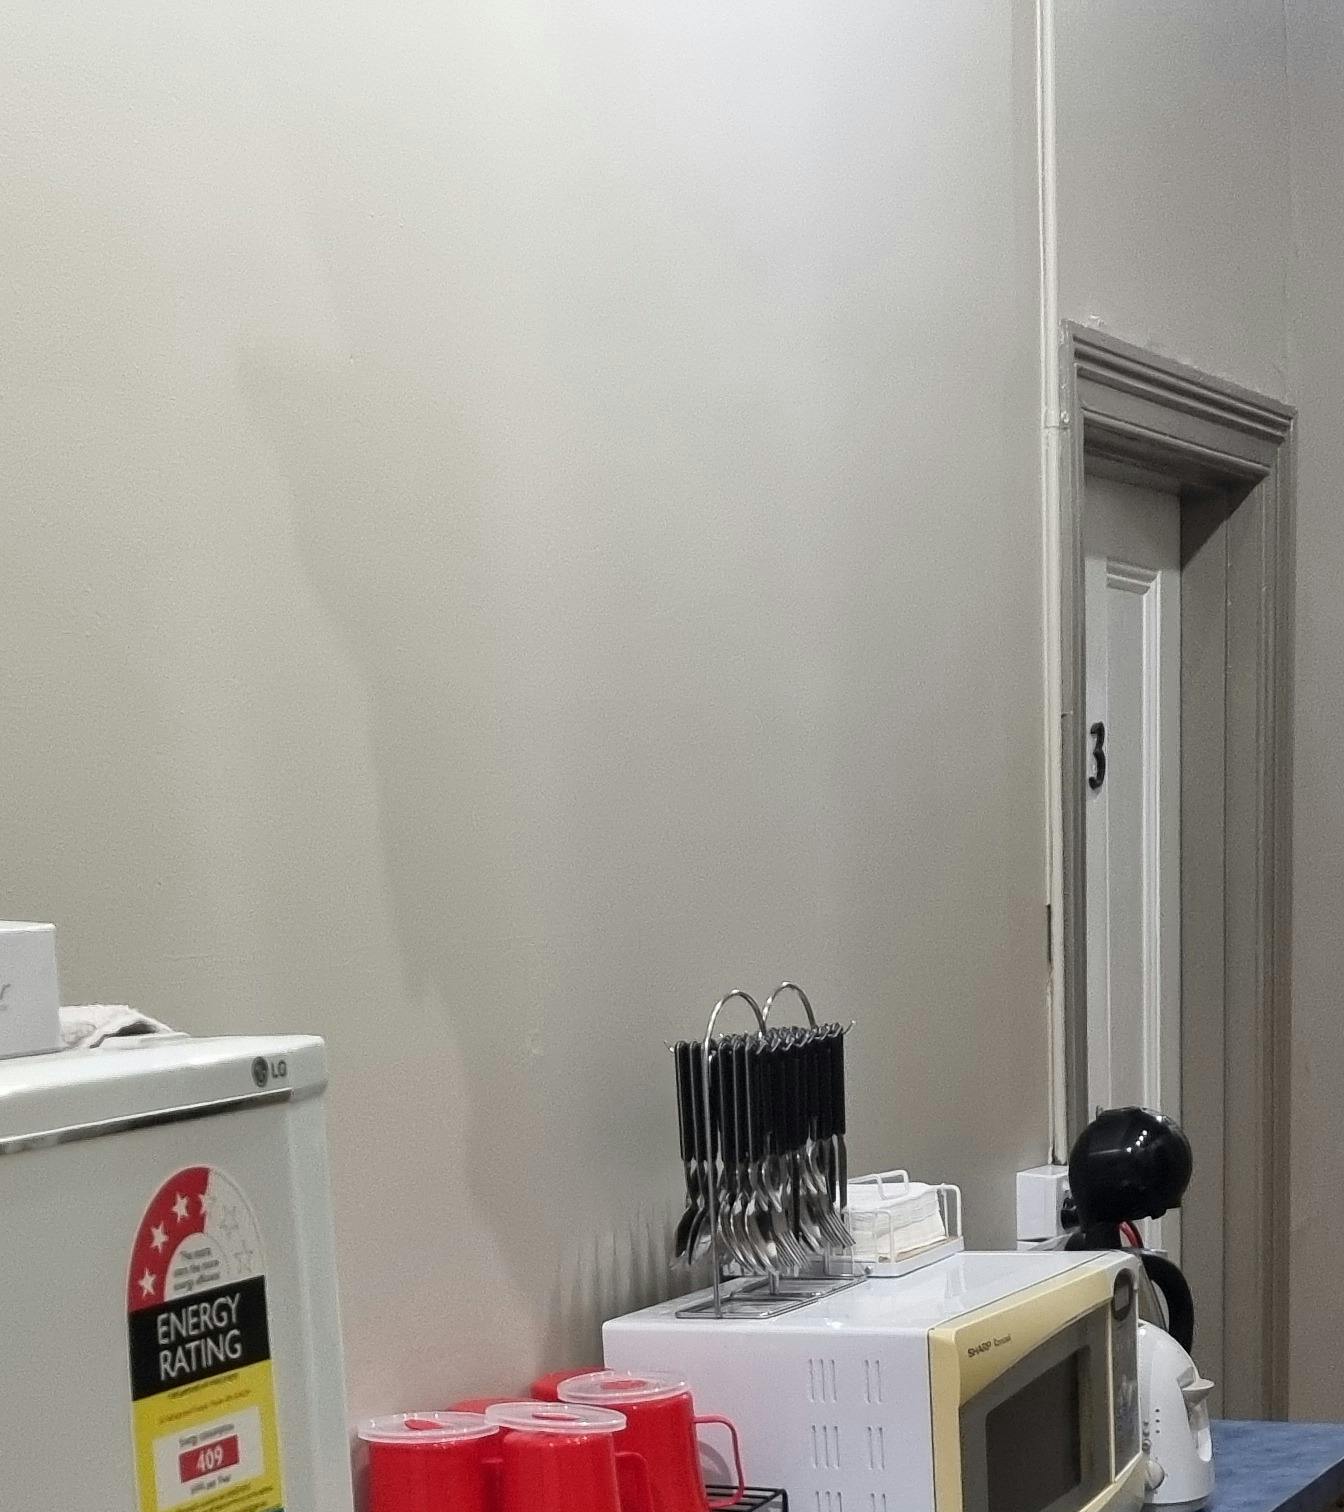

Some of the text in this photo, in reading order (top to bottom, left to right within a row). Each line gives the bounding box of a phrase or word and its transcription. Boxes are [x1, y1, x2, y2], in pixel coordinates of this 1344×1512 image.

[1088, 721, 1106, 790] 3
[270, 1060, 287, 1079] LG
[157, 1293, 241, 1345] ENERGY
[159, 1329, 243, 1381] RATING
[967, 1340, 992, 1358] SHARP
[196, 1442, 224, 1473] 409
